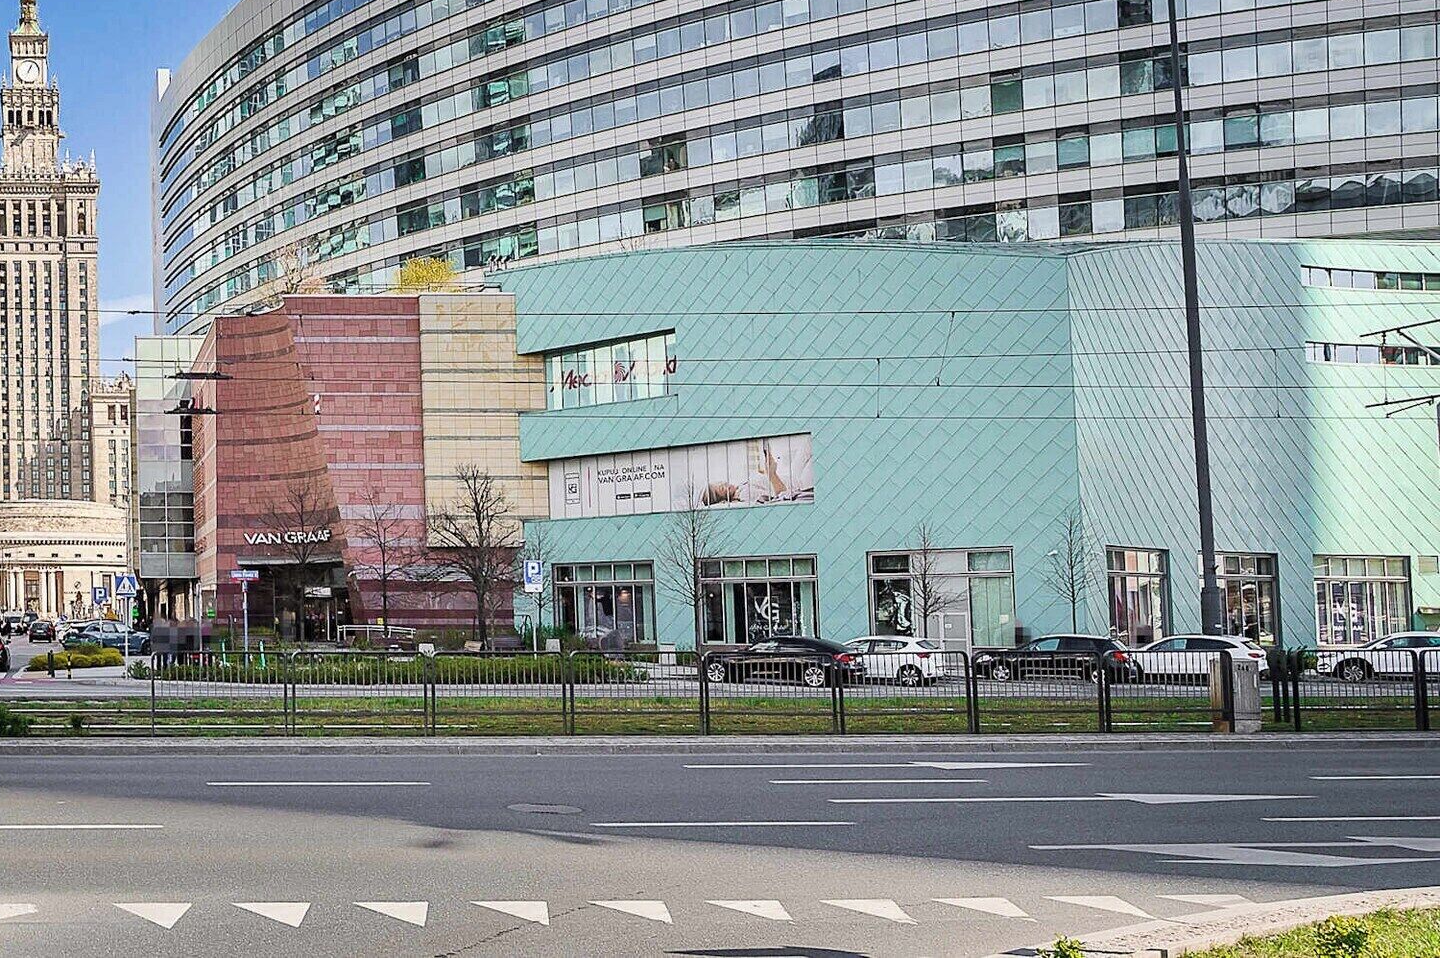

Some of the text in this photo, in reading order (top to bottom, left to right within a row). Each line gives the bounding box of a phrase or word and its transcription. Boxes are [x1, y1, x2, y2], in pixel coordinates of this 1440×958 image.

[597, 463, 665, 477] KUPUJ ONLINE NA
[243, 529, 331, 545] VAN GRAAF
[527, 562, 539, 578] P
[95, 587, 105, 600] P
